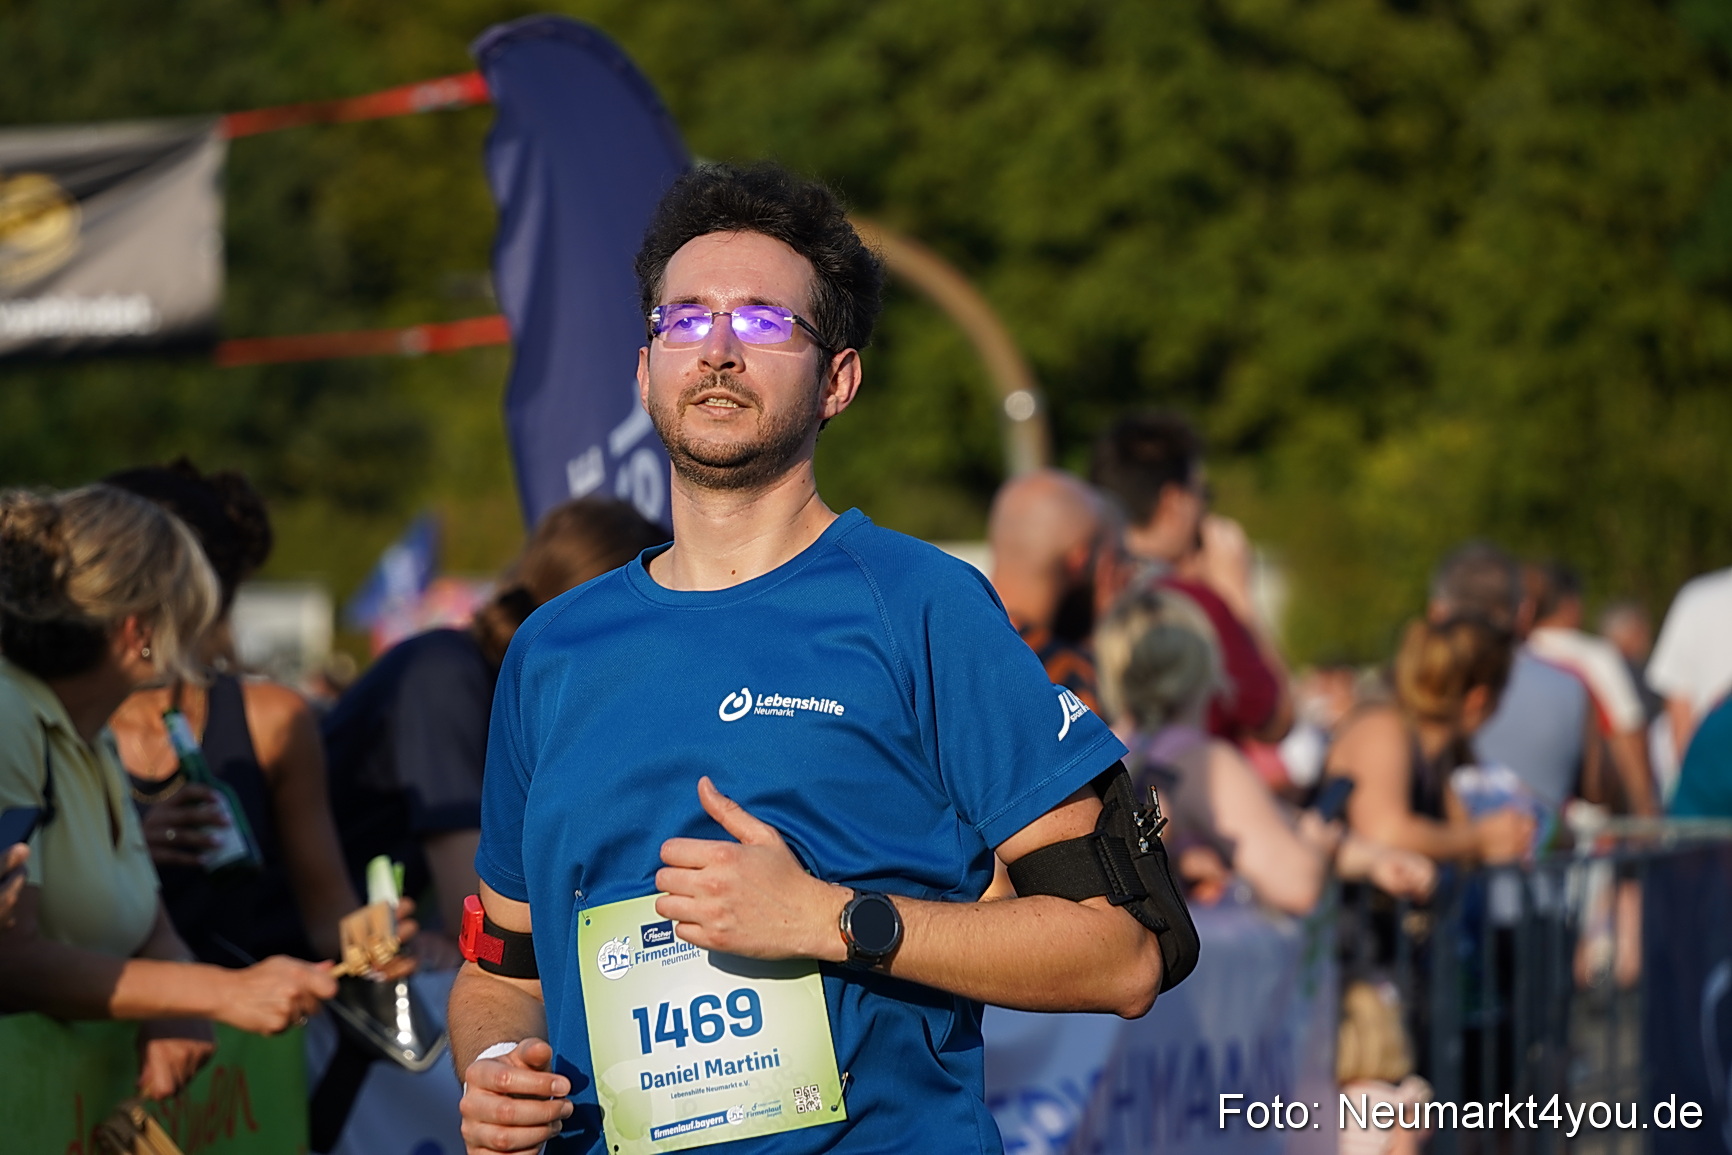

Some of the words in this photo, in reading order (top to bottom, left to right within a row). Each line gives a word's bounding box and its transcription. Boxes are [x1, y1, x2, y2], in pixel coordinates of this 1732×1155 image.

[754, 706, 795, 717] Neumarkt
[756, 693, 845, 716] Lebenshilfe
[635, 941, 700, 965] Firmenlau
[661, 949, 701, 967] neumarkt
[632, 988, 763, 1055] 1469
[640, 1062, 700, 1091] Daniel
[704, 1048, 780, 1079] Martini
[670, 1087, 705, 1099] Lebenshilfe
[705, 1082, 738, 1093] Neumarkt
[746, 1104, 782, 1118] Firmenlauf
[653, 1115, 724, 1140] firmenlauf.bayern
